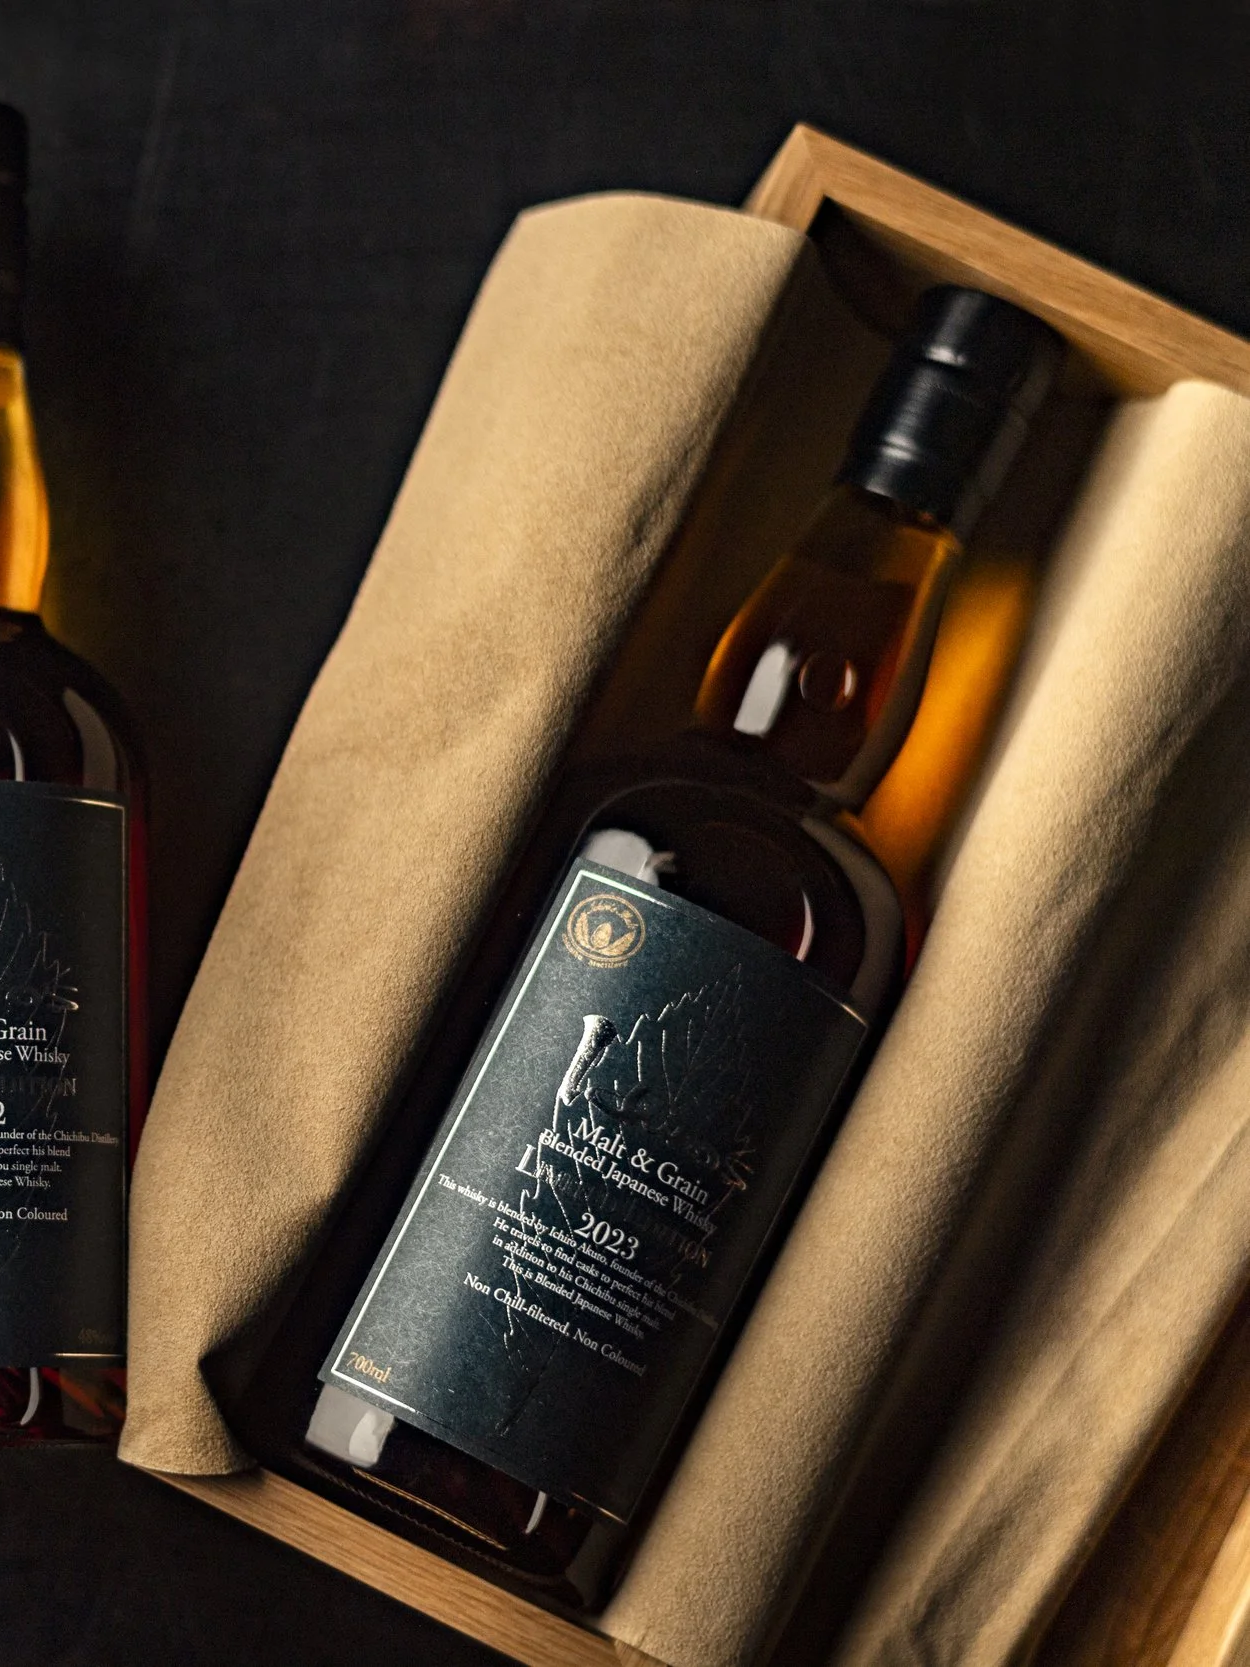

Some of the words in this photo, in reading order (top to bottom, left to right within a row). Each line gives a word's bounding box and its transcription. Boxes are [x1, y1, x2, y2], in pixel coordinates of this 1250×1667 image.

[14, 1044, 70, 1064] Whisky
[26, 1128, 37, 1139] of
[38, 1130, 51, 1139] the
[53, 1129, 89, 1141] Chichibu
[32, 1145, 45, 1155] his
[48, 1145, 70, 1156] blend
[573, 1116, 628, 1158] Malt
[630, 1147, 655, 1173] &
[654, 1159, 713, 1204] Grain
[11, 1159, 37, 1173] single
[539, 1127, 605, 1171] Blended
[602, 1160, 671, 1209] Japanese
[667, 1195, 720, 1235] Whisky
[16, 1206, 67, 1221] Coloured
[437, 1173, 456, 1190] This
[456, 1182, 487, 1206] whisky
[489, 1197, 496, 1208] is
[497, 1201, 534, 1226] blended
[534, 1219, 548, 1235] by
[549, 1226, 577, 1247] Ichiro
[610, 1258, 643, 1282] founder
[574, 1211, 641, 1261] 2023
[493, 1234, 503, 1246] in
[547, 1262, 556, 1273] to
[559, 1267, 573, 1281] his
[574, 1274, 617, 1304] Chichibu
[494, 1216, 508, 1231] He
[541, 1242, 552, 1253] to
[554, 1246, 574, 1264] find
[576, 1258, 599, 1277] casks
[601, 1273, 610, 1283] to
[611, 1277, 641, 1301] perfect
[463, 1272, 491, 1295] Non
[573, 1327, 599, 1350] Non
[501, 1255, 523, 1273] This
[525, 1267, 533, 1279] is
[535, 1272, 573, 1299] Blended
[573, 1292, 612, 1321] Japanese
[347, 1351, 393, 1383] 700ml
